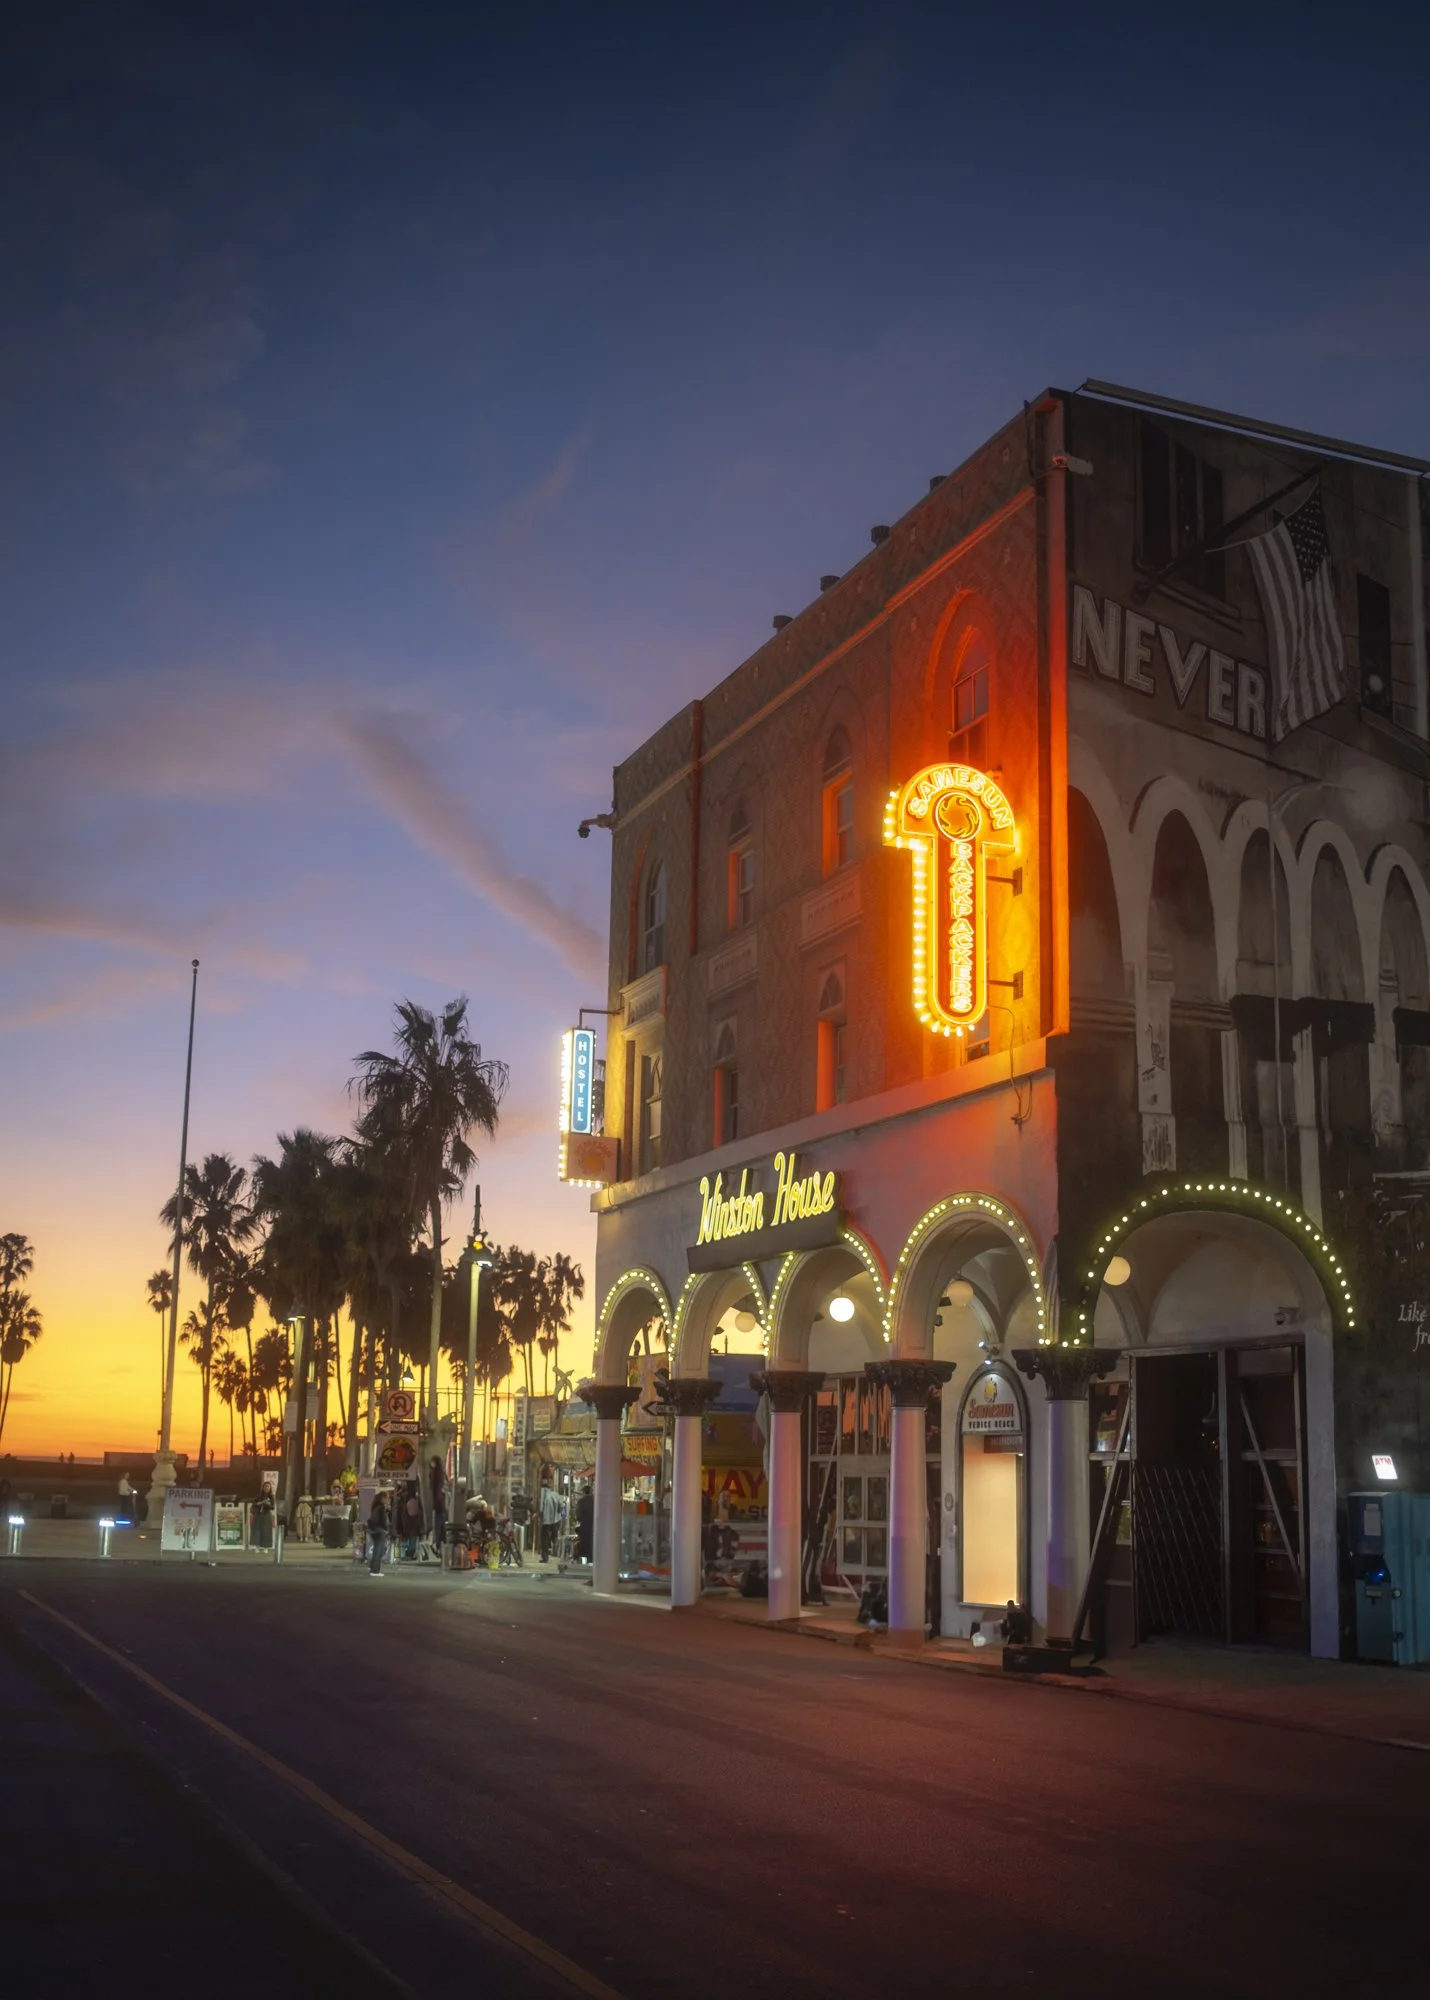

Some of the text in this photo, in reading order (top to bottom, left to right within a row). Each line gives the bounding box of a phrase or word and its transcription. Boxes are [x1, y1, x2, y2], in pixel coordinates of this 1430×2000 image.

[1071, 583, 1267, 739] NEVER
[908, 767, 1013, 831] SAMESUN
[948, 841, 974, 1013] BACKPACKERS
[577, 1040, 588, 1122] HOSTEL
[696, 1151, 835, 1245] Winston House
[1397, 1300, 1428, 1322] Like
[627, 1437, 658, 1451] SURFING
[968, 1420, 1014, 1429] VENICE BEACH
[1375, 1457, 1392, 1466] ATM
[168, 1489, 211, 1500] PARKING
